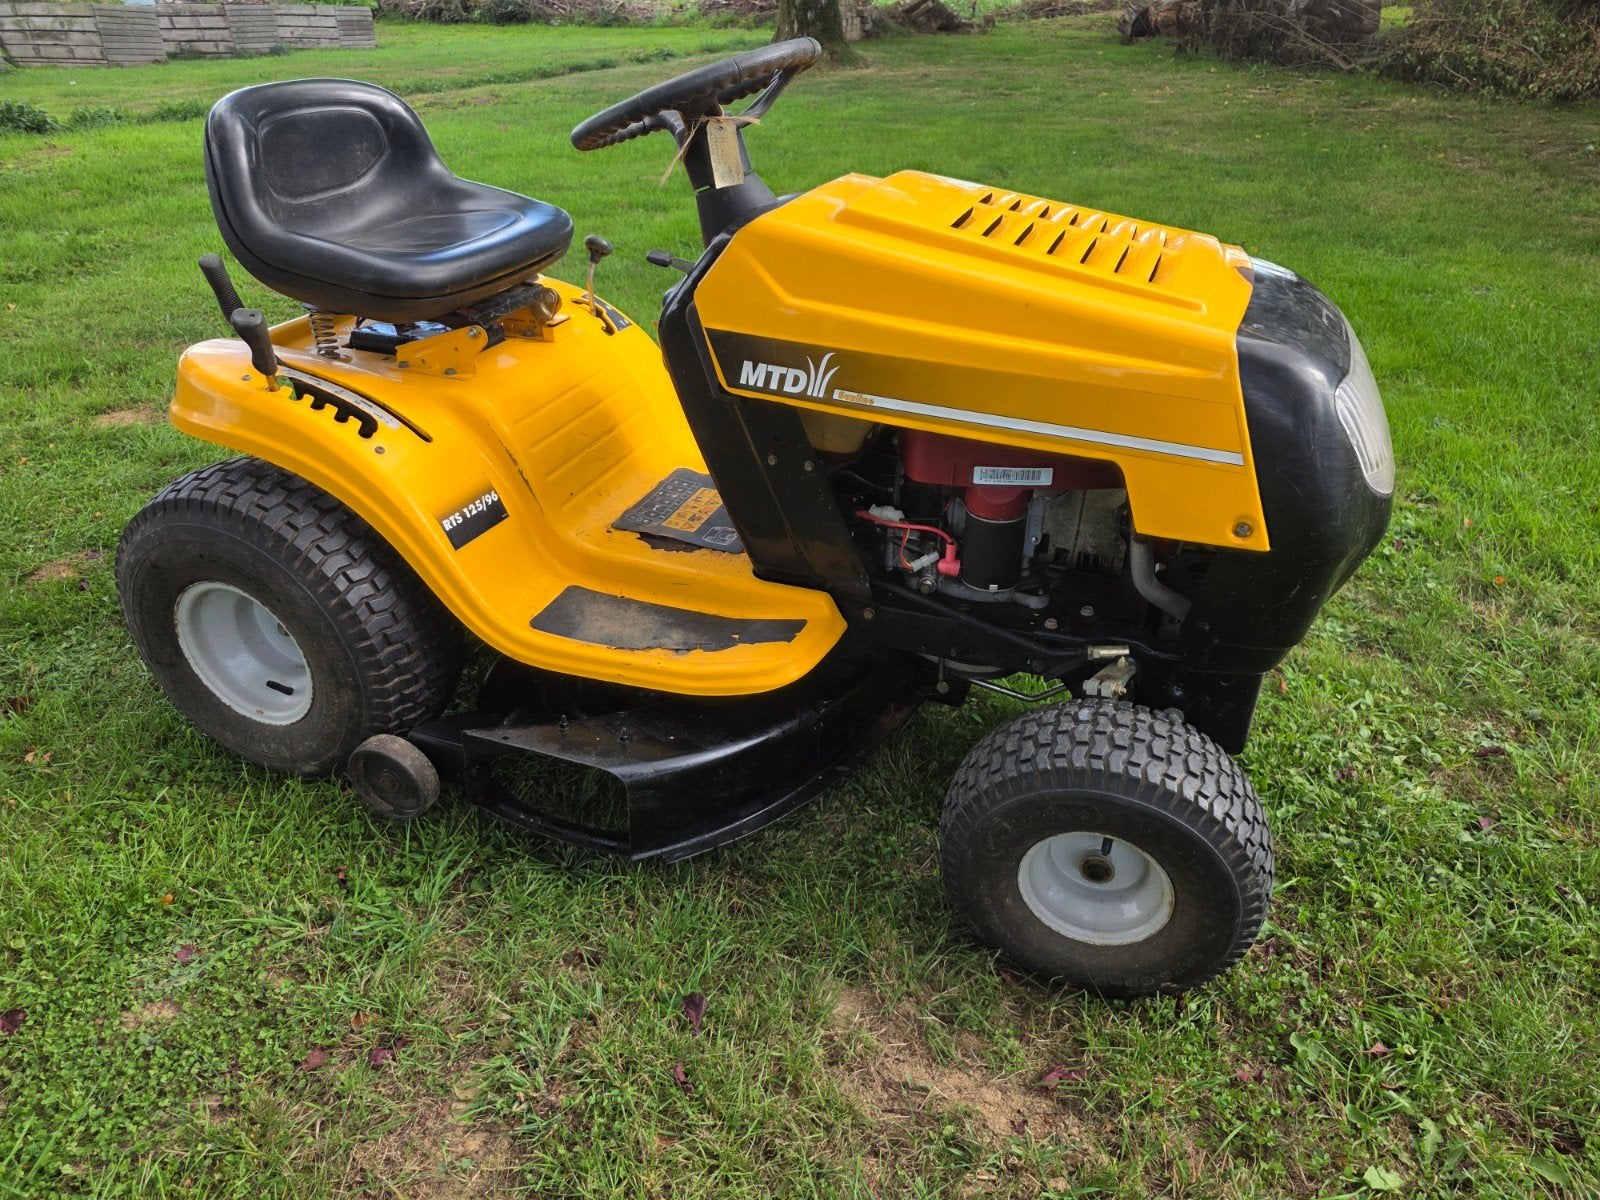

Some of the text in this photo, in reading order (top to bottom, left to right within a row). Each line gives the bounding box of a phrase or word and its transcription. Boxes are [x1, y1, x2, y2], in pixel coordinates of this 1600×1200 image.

[739, 360, 808, 394] MTD
[442, 490, 499, 531] RTS 125/96
